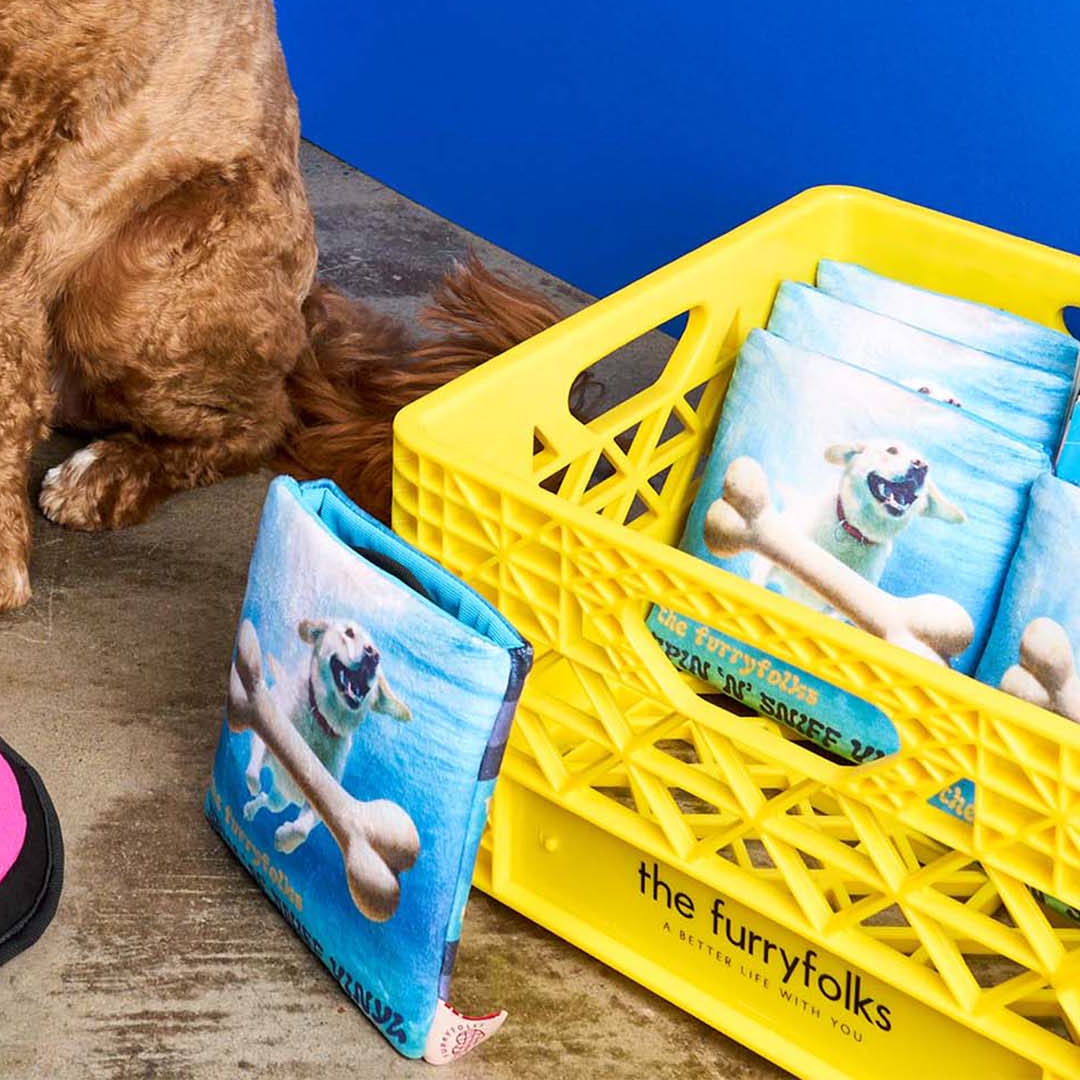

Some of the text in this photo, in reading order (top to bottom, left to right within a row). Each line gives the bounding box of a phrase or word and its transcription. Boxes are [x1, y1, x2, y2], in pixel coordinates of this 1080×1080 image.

[657, 606, 820, 707] the furryfolks
[760, 691, 842, 749] SNIFF
[638, 861, 892, 1032] the furryfolks
[663, 922, 863, 1042] A BETTER LIFE WITH YOU
